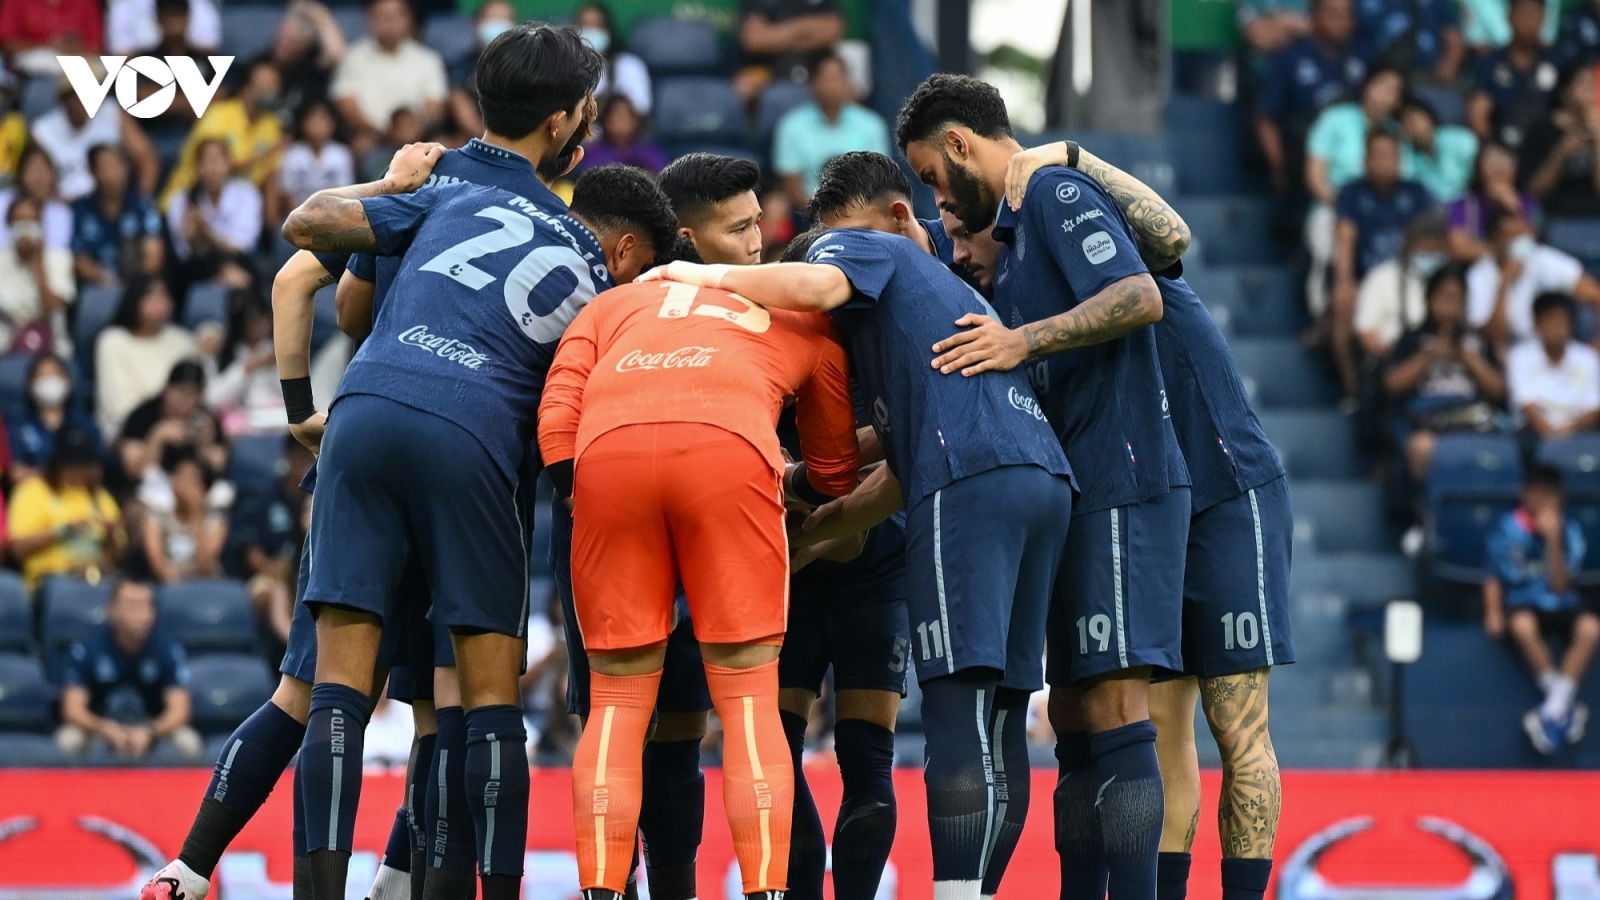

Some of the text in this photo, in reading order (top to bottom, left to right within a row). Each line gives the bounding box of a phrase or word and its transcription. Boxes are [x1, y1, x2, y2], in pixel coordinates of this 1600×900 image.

[1060, 187, 1075, 198] CP
[418, 206, 600, 344] 20
[917, 619, 943, 660] 11
[1076, 614, 1111, 654] 19
[1221, 612, 1259, 650] 10
[887, 635, 907, 673] 5
[1241, 794, 1266, 814] PAZ
